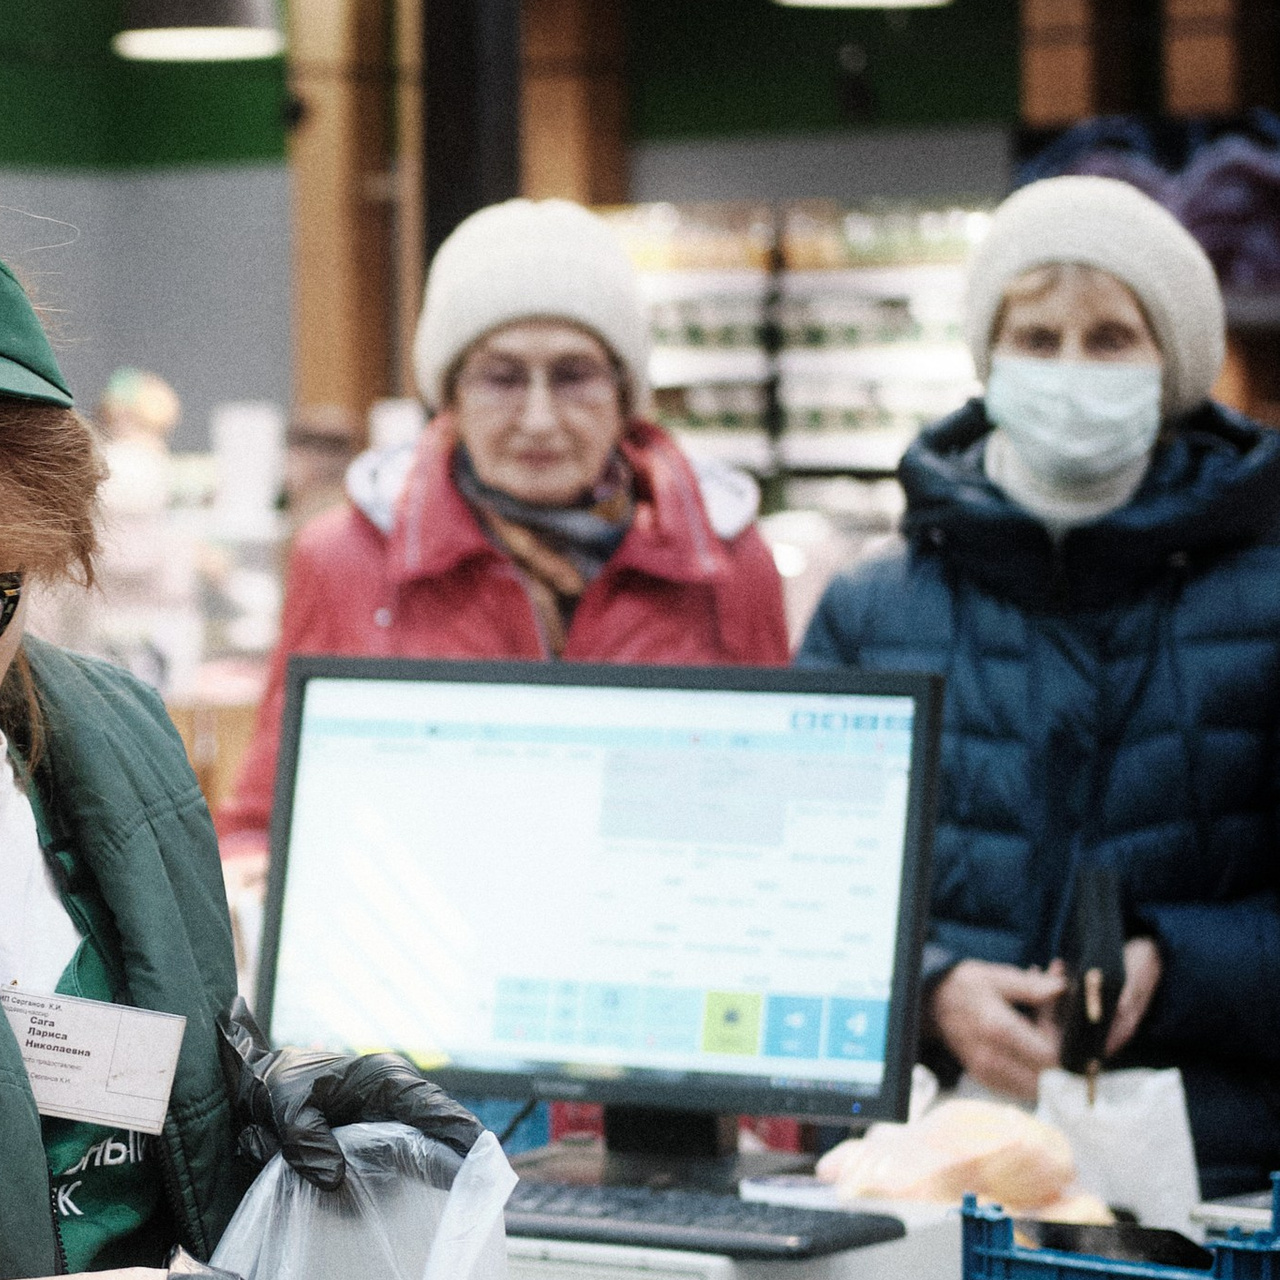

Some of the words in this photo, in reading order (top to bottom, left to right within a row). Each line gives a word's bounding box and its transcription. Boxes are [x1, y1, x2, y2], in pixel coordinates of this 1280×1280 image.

[30, 1016, 55, 1027] Сага
[28, 1027, 68, 1040] Лариса
[25, 1039, 91, 1057] Николаевна
